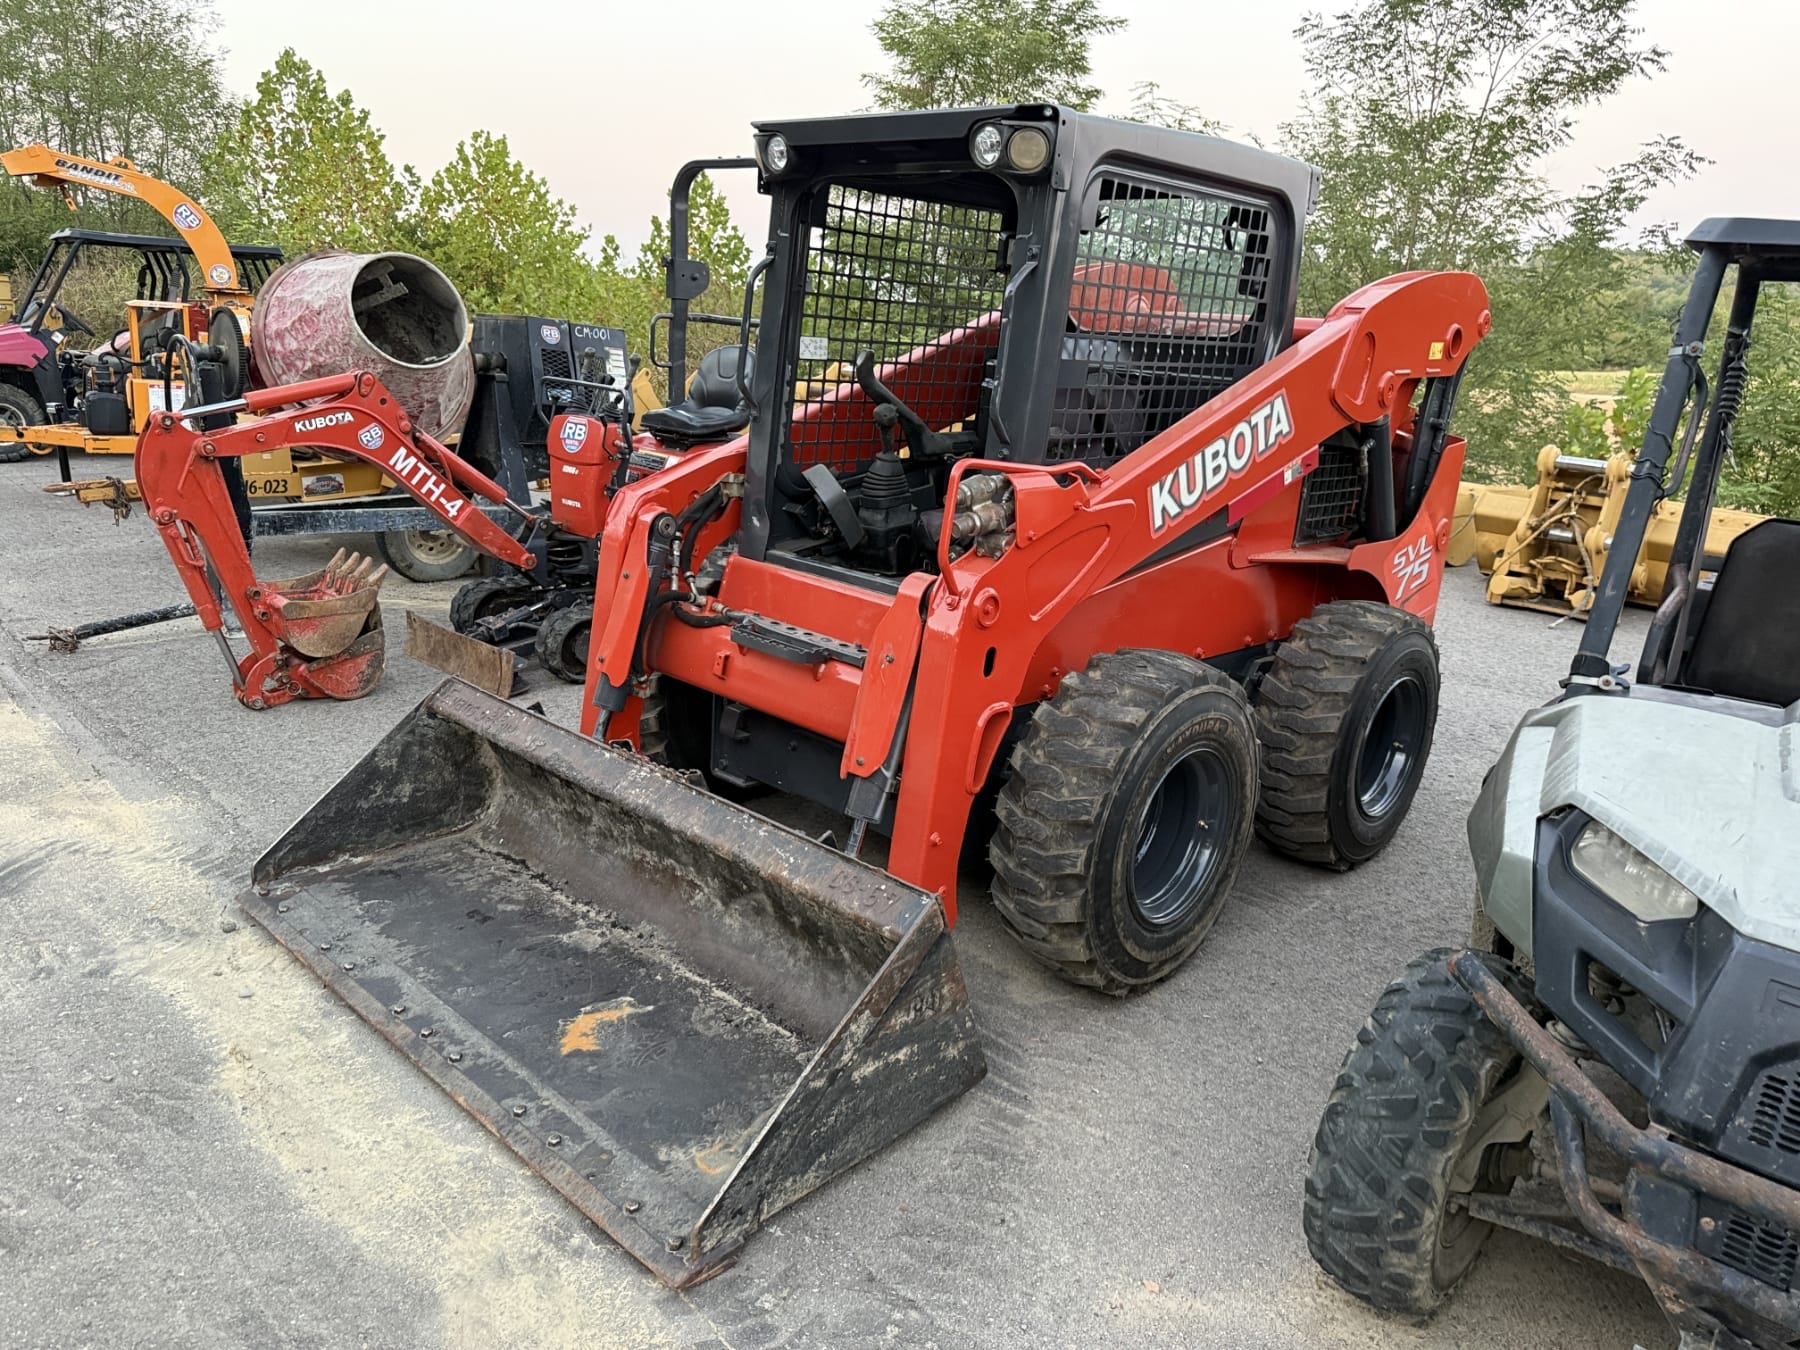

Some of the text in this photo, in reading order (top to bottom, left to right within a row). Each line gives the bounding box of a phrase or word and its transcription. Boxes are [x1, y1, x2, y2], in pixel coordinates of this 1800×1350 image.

[54, 158, 123, 181] BANDIT
[176, 204, 201, 228] RB
[543, 330, 559, 338] RB
[294, 411, 355, 433] KUBOTA
[563, 422, 586, 440] RB
[361, 427, 382, 445] RB
[1151, 395, 1291, 529] KUBOTA
[388, 446, 464, 518] MTH-4
[1391, 534, 1434, 575] SVL
[1395, 552, 1433, 601] 75
